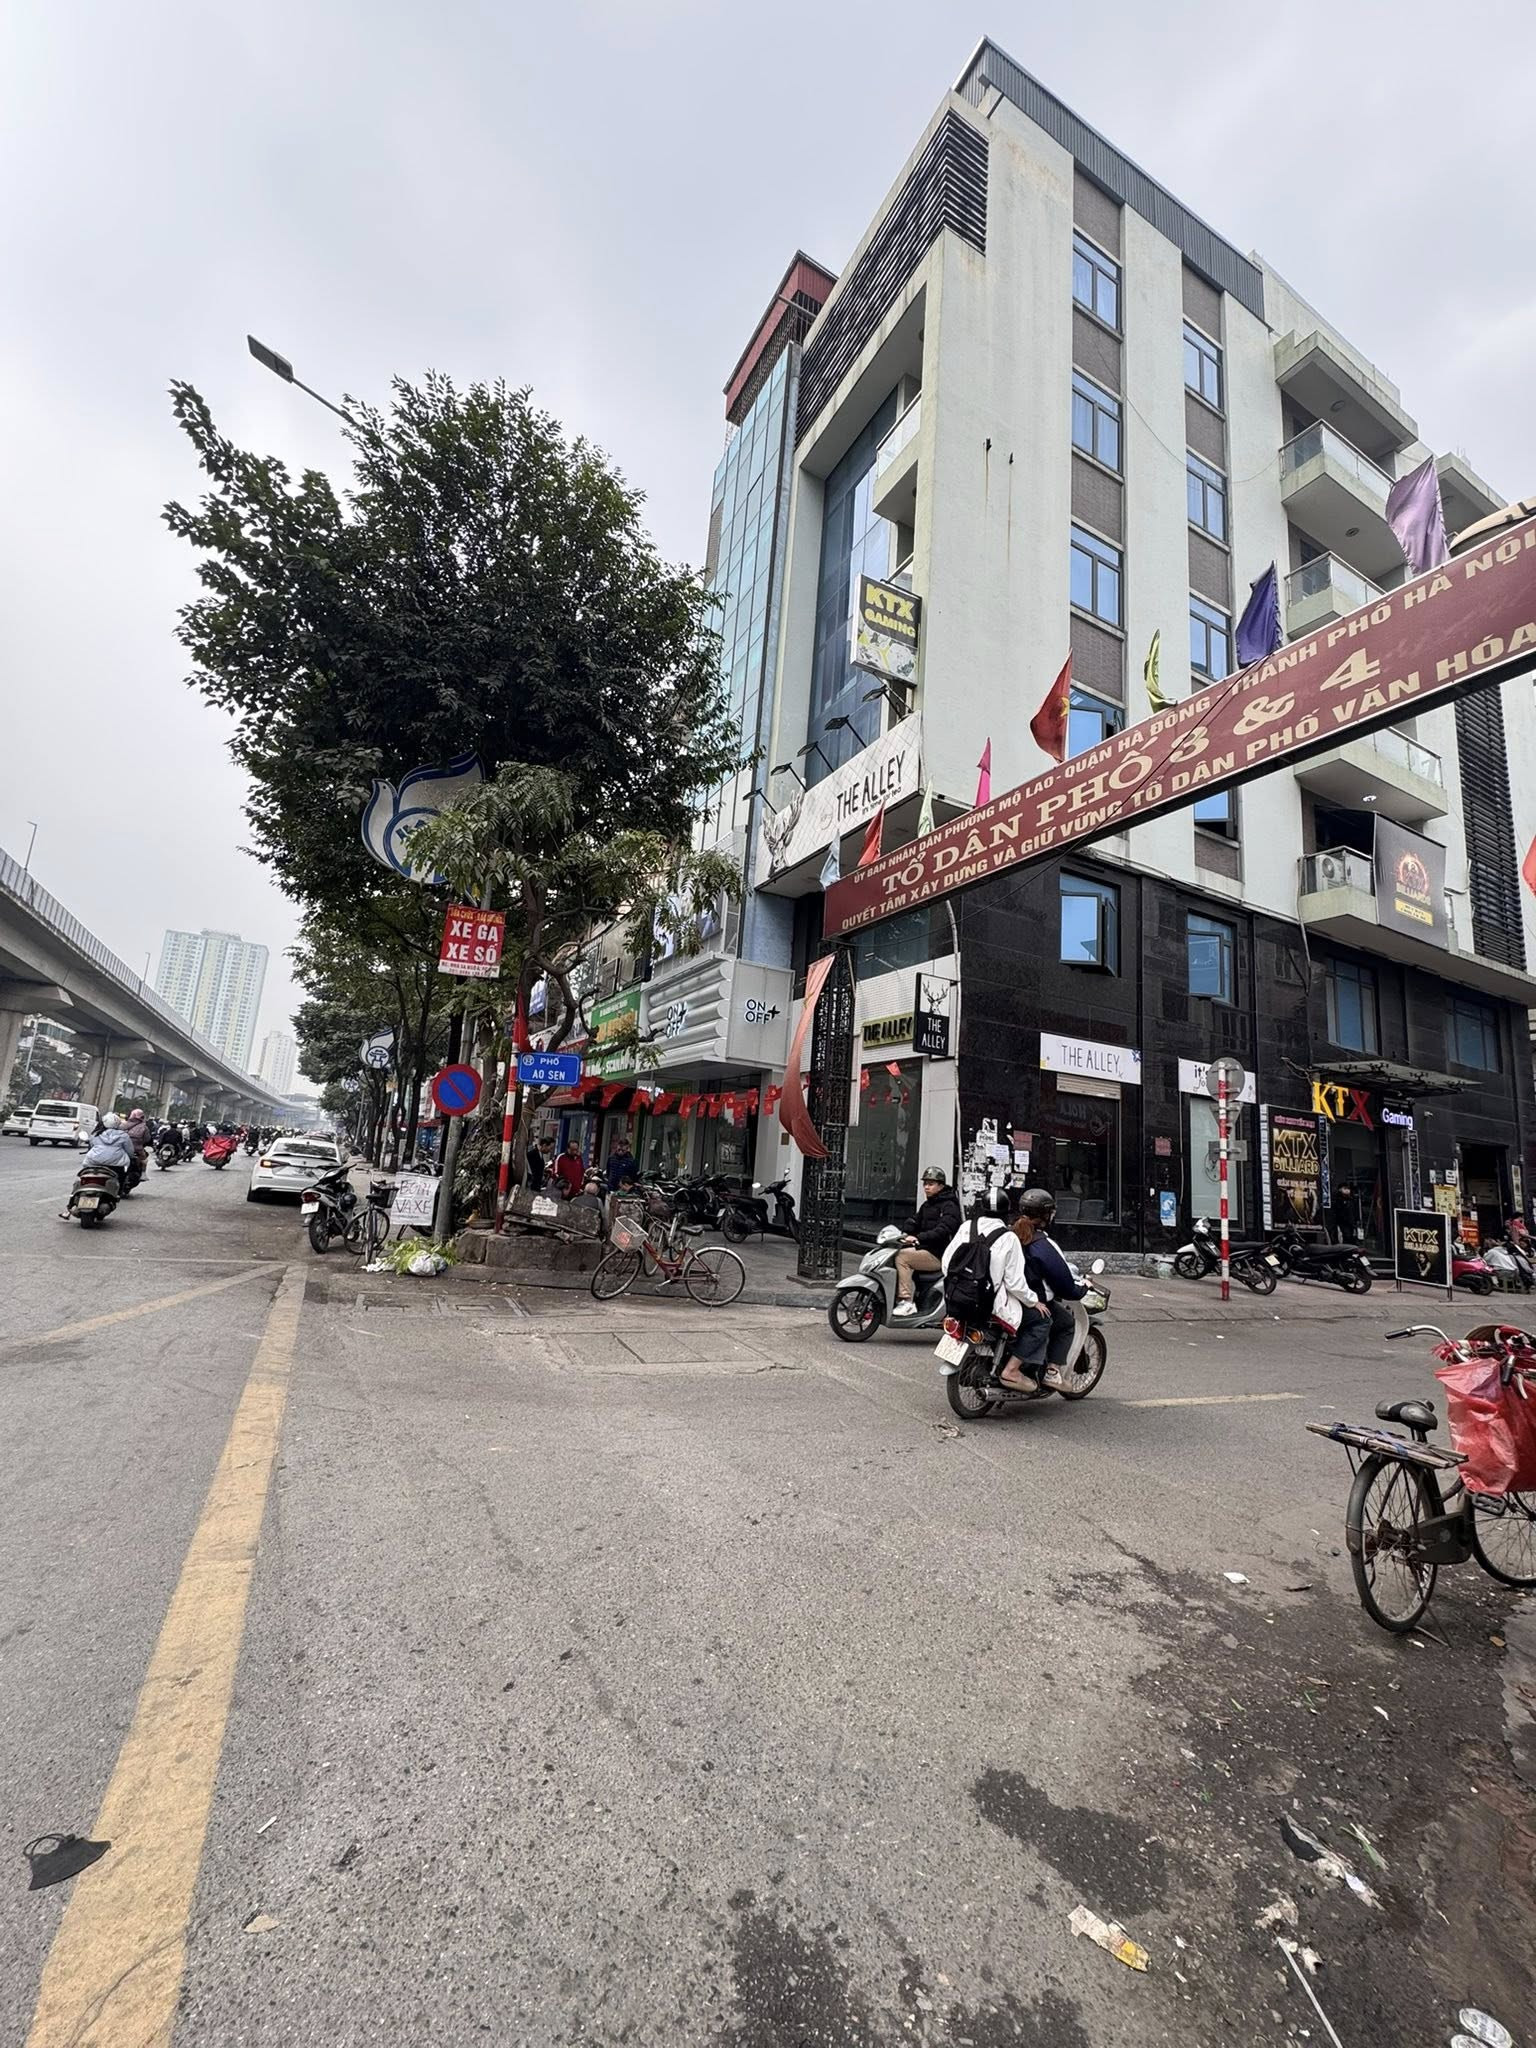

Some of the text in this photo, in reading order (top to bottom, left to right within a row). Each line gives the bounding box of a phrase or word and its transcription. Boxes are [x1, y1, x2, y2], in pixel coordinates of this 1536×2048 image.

[865, 583, 915, 622] KTX
[864, 608, 916, 638] GAMING
[853, 869, 864, 884] ỦY
[867, 862, 886, 879] BAN
[888, 846, 916, 867] NHÂN
[919, 835, 942, 855] DÂN
[945, 806, 995, 839] PHƯỜNG
[999, 790, 1020, 811] MỘ
[1025, 777, 1054, 799] LAO
[1064, 746, 1112, 779] QUẬN
[1118, 728, 1144, 752] HÀ
[1150, 698, 1211, 735] ĐÔNG
[1231, 641, 1318, 696] THÀNH
[1327, 596, 1393, 648] PHỐ
[1404, 573, 1453, 610] HÀ
[1465, 529, 1536, 580] NỘI
[841, 622, 1536, 930] QUYẾT TÂM XÂY DỰNG VÀ GIỮ VỮNG TỔ DÂN PHỐ VĂN HÓA
[882, 647, 1381, 895] TỔ DÂN PHỐ 3 & 4
[837, 750, 905, 821] THE ALLEY
[450, 920, 499, 942] XE GA
[446, 942, 498, 964] XE SỐ
[746, 998, 766, 1012] ON
[928, 1017, 942, 1033] THE
[921, 1033, 946, 1049] ALLEY
[1061, 1044, 1120, 1074] THE ALLEY
[532, 1069, 566, 1081] AO SEN
[1312, 1081, 1374, 1131] KTX
[1382, 1108, 1413, 1130] Gaming
[1273, 1128, 1318, 1160] KTX
[1273, 1156, 1320, 1175] BILLIARD
[1403, 1227, 1439, 1244] KTX
